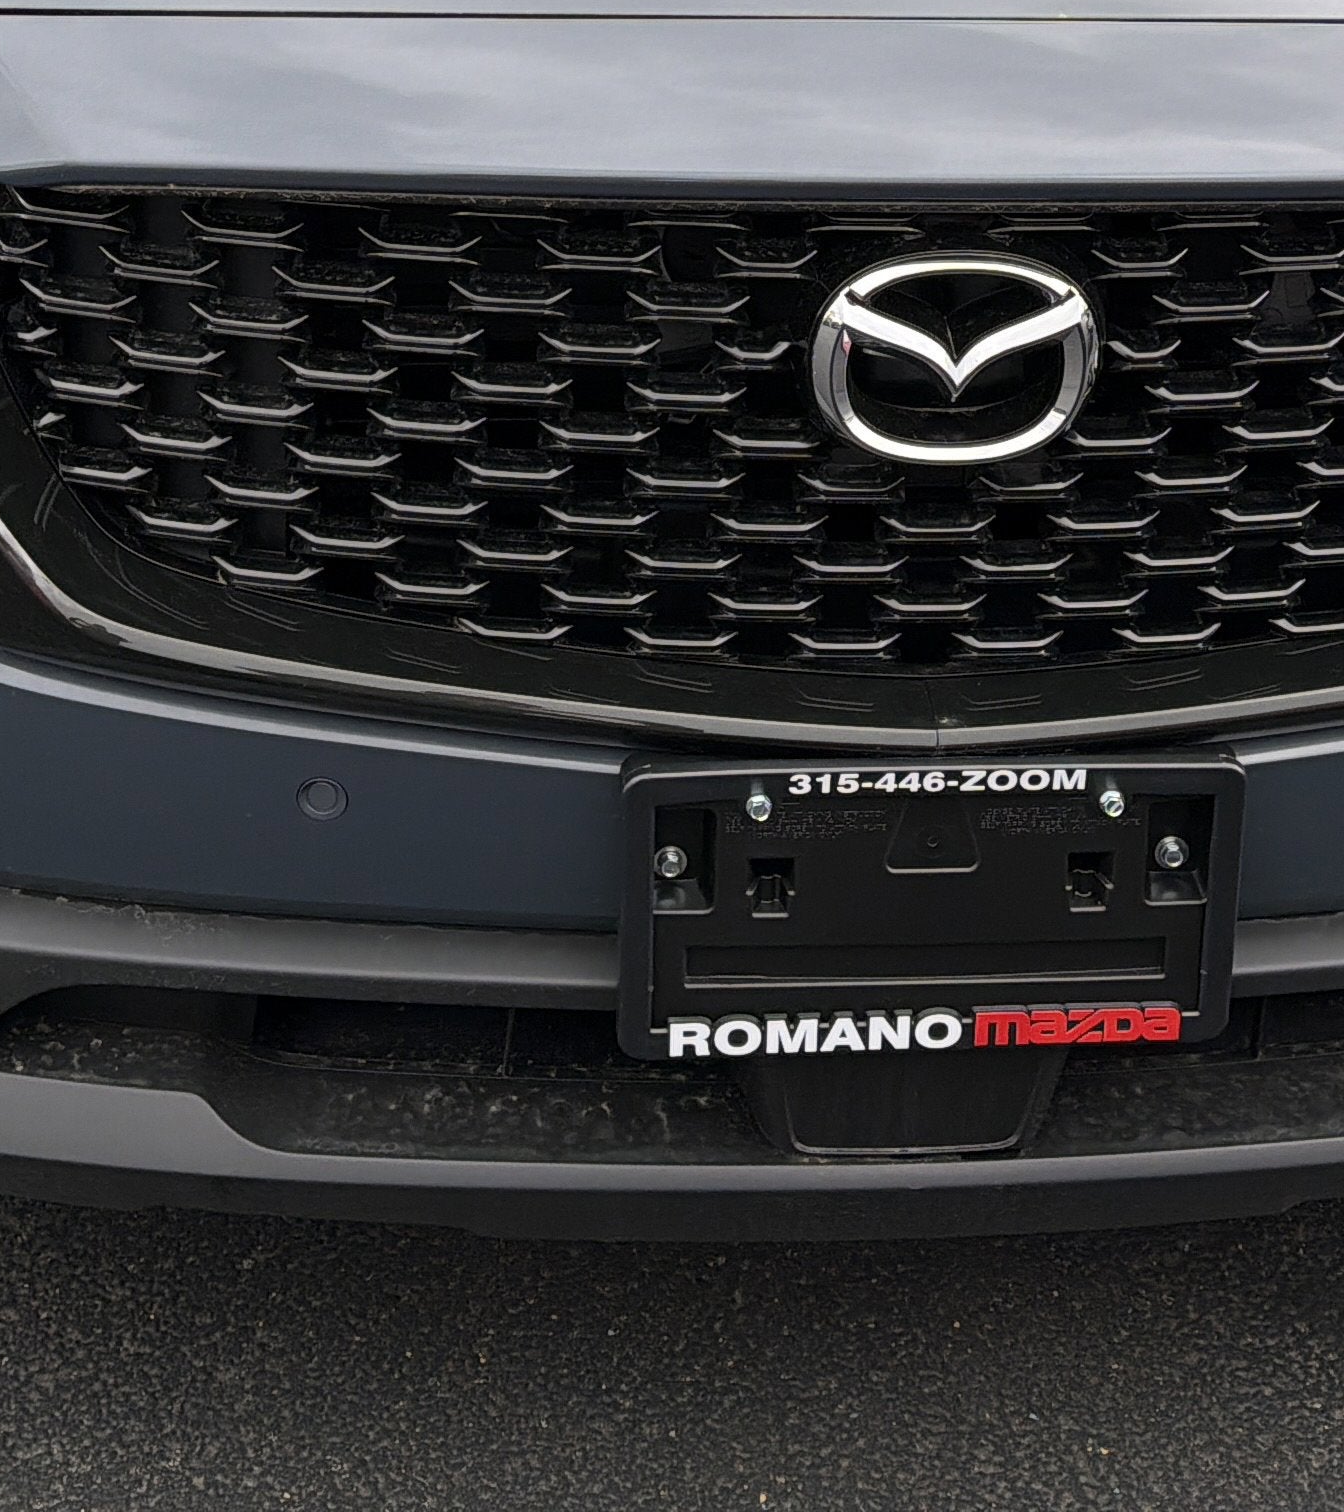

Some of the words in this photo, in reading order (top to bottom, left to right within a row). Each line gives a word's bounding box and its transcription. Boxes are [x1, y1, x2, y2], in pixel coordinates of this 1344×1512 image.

[788, 769, 1087, 795] 315-446-ZOOM
[668, 1011, 963, 1058] ROMANO
[973, 1005, 1182, 1047] mazda
